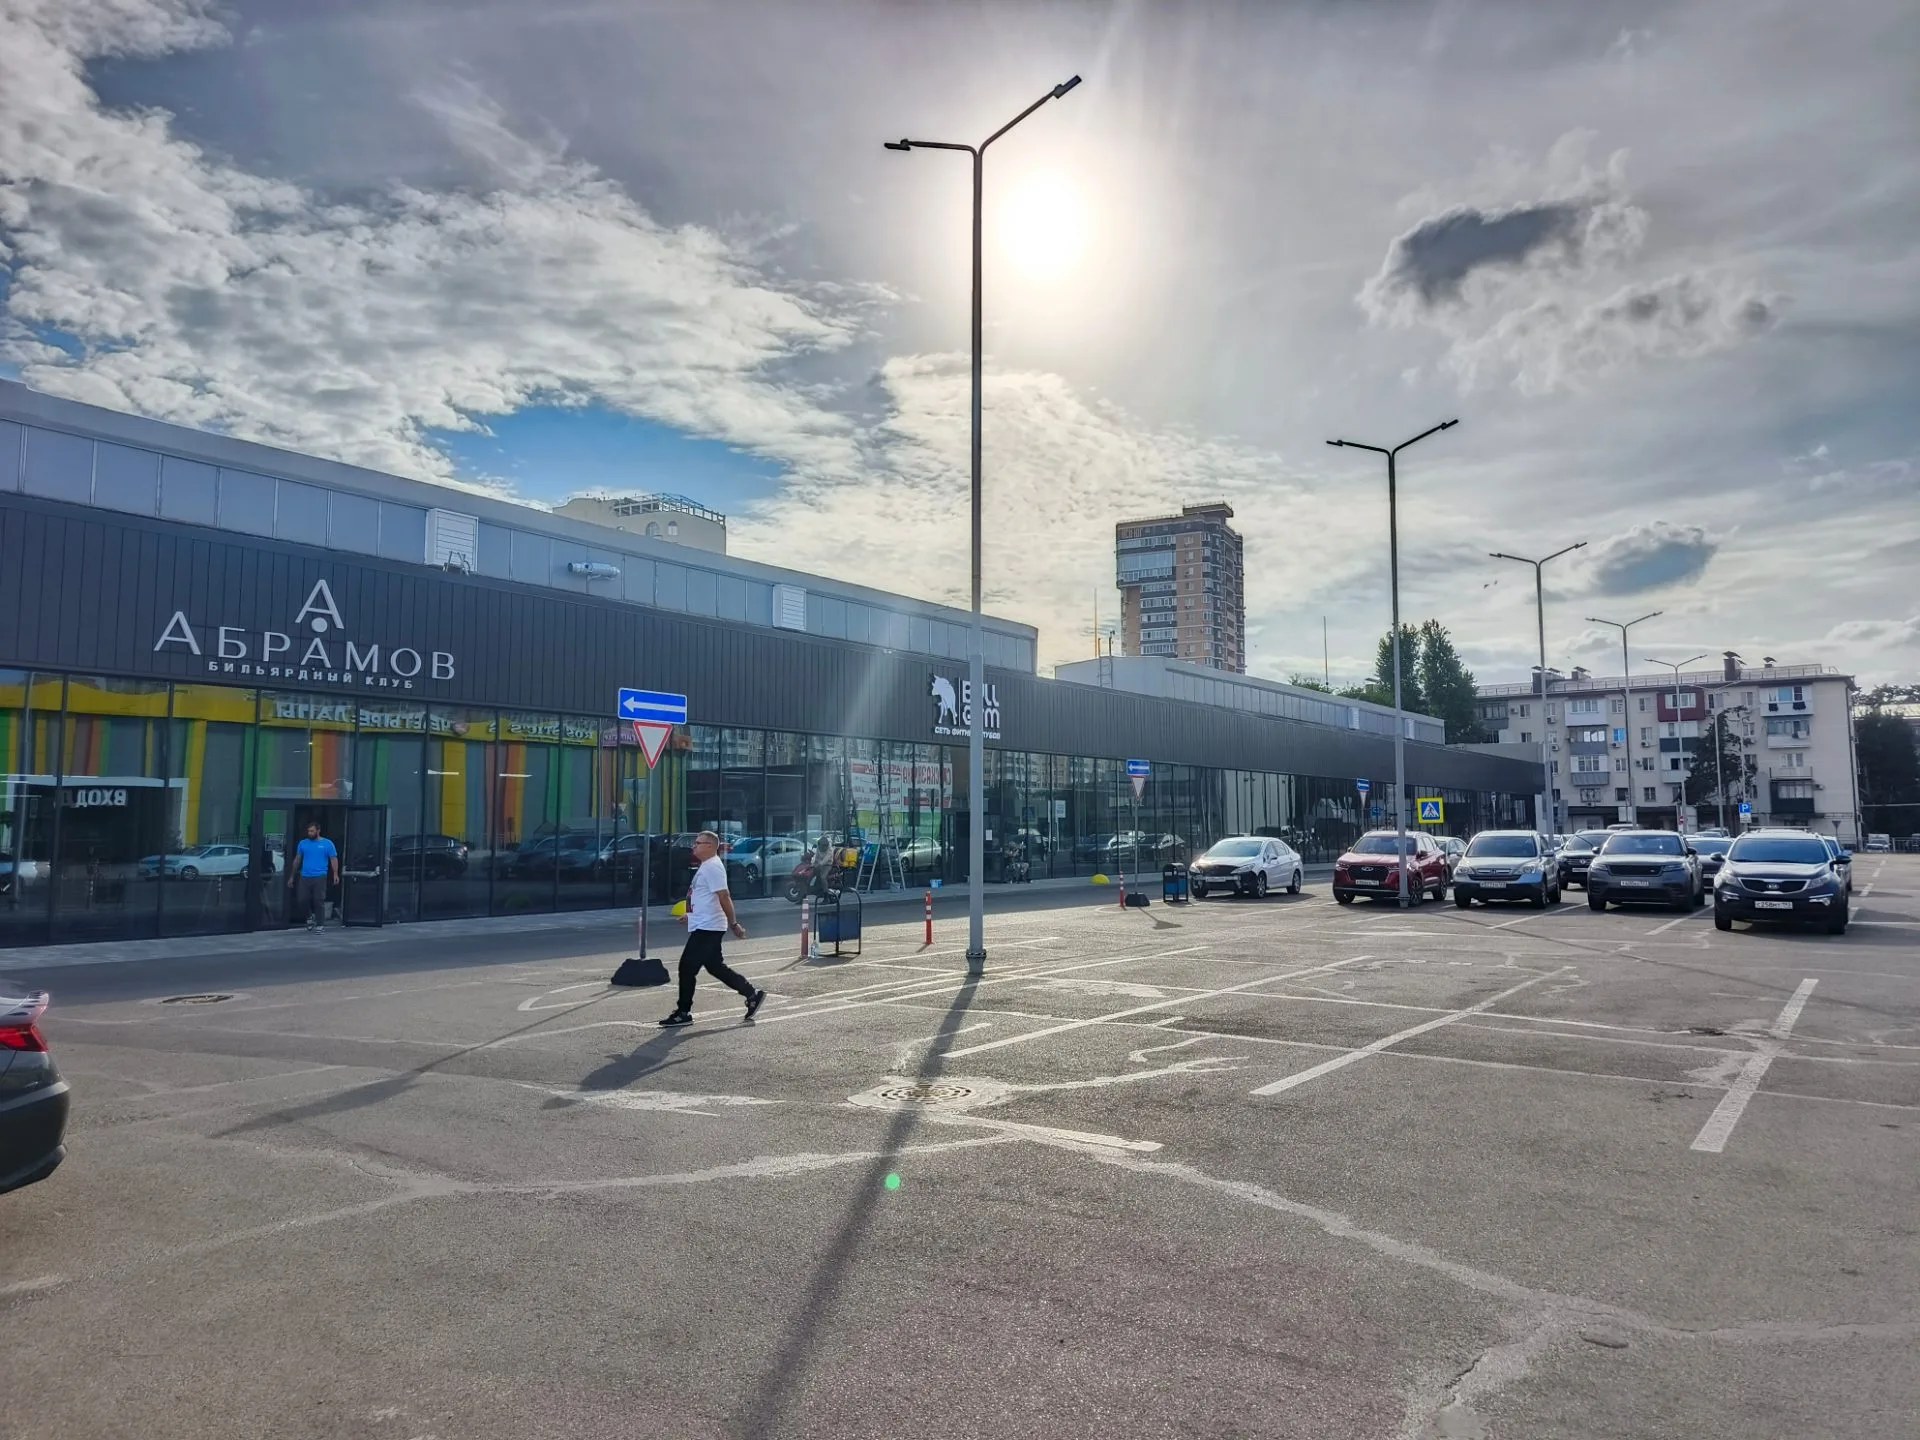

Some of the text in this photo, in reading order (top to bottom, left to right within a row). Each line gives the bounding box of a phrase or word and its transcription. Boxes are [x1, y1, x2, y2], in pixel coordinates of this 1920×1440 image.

[153, 611, 455, 680] АБРАМОВ
[208, 661, 413, 689] БИЛЬЯРДНЫЙ КЛУБ
[962, 680, 999, 707] BLL
[962, 705, 1000, 728] GM
[934, 726, 951, 735] СЕТЬ
